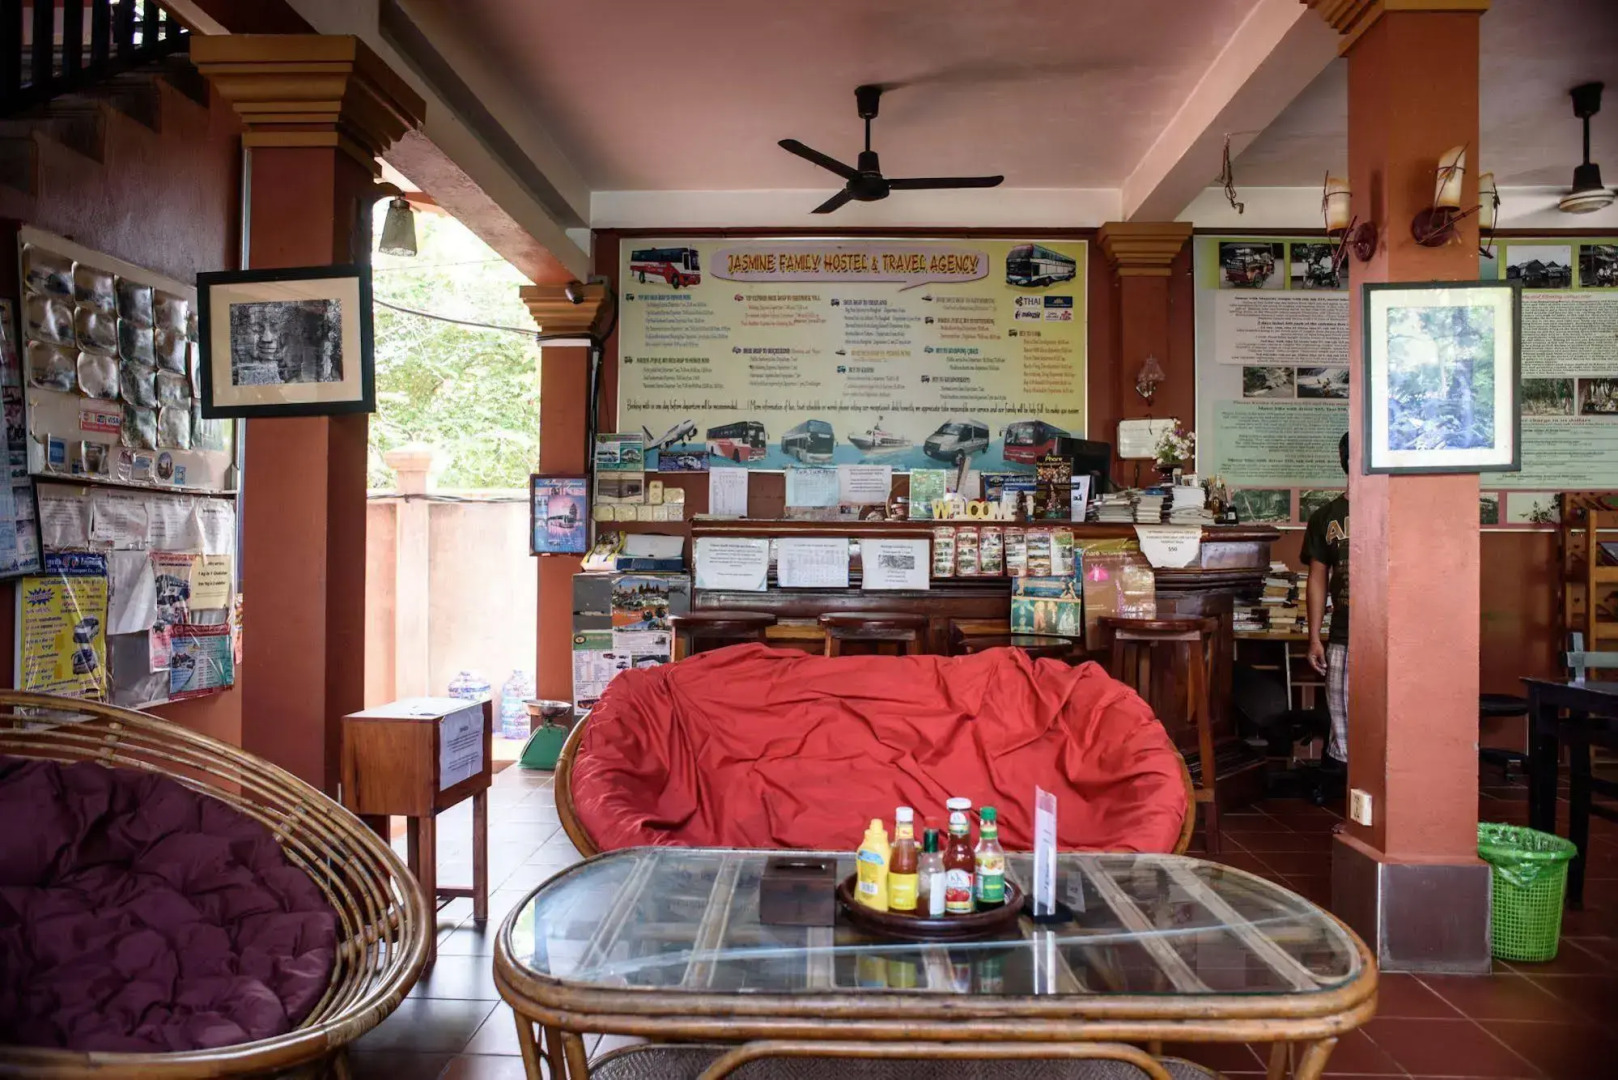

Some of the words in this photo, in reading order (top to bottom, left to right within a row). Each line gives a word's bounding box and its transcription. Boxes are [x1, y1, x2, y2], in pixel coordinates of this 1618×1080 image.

[727, 254, 775, 275] JASMINE
[779, 254, 821, 274] FAMILY
[823, 254, 868, 274] HOSTEL
[871, 256, 879, 273] &
[883, 254, 926, 274] TRAVEL
[929, 254, 980, 274] AGENCY
[1024, 297, 1041, 305] THAI
